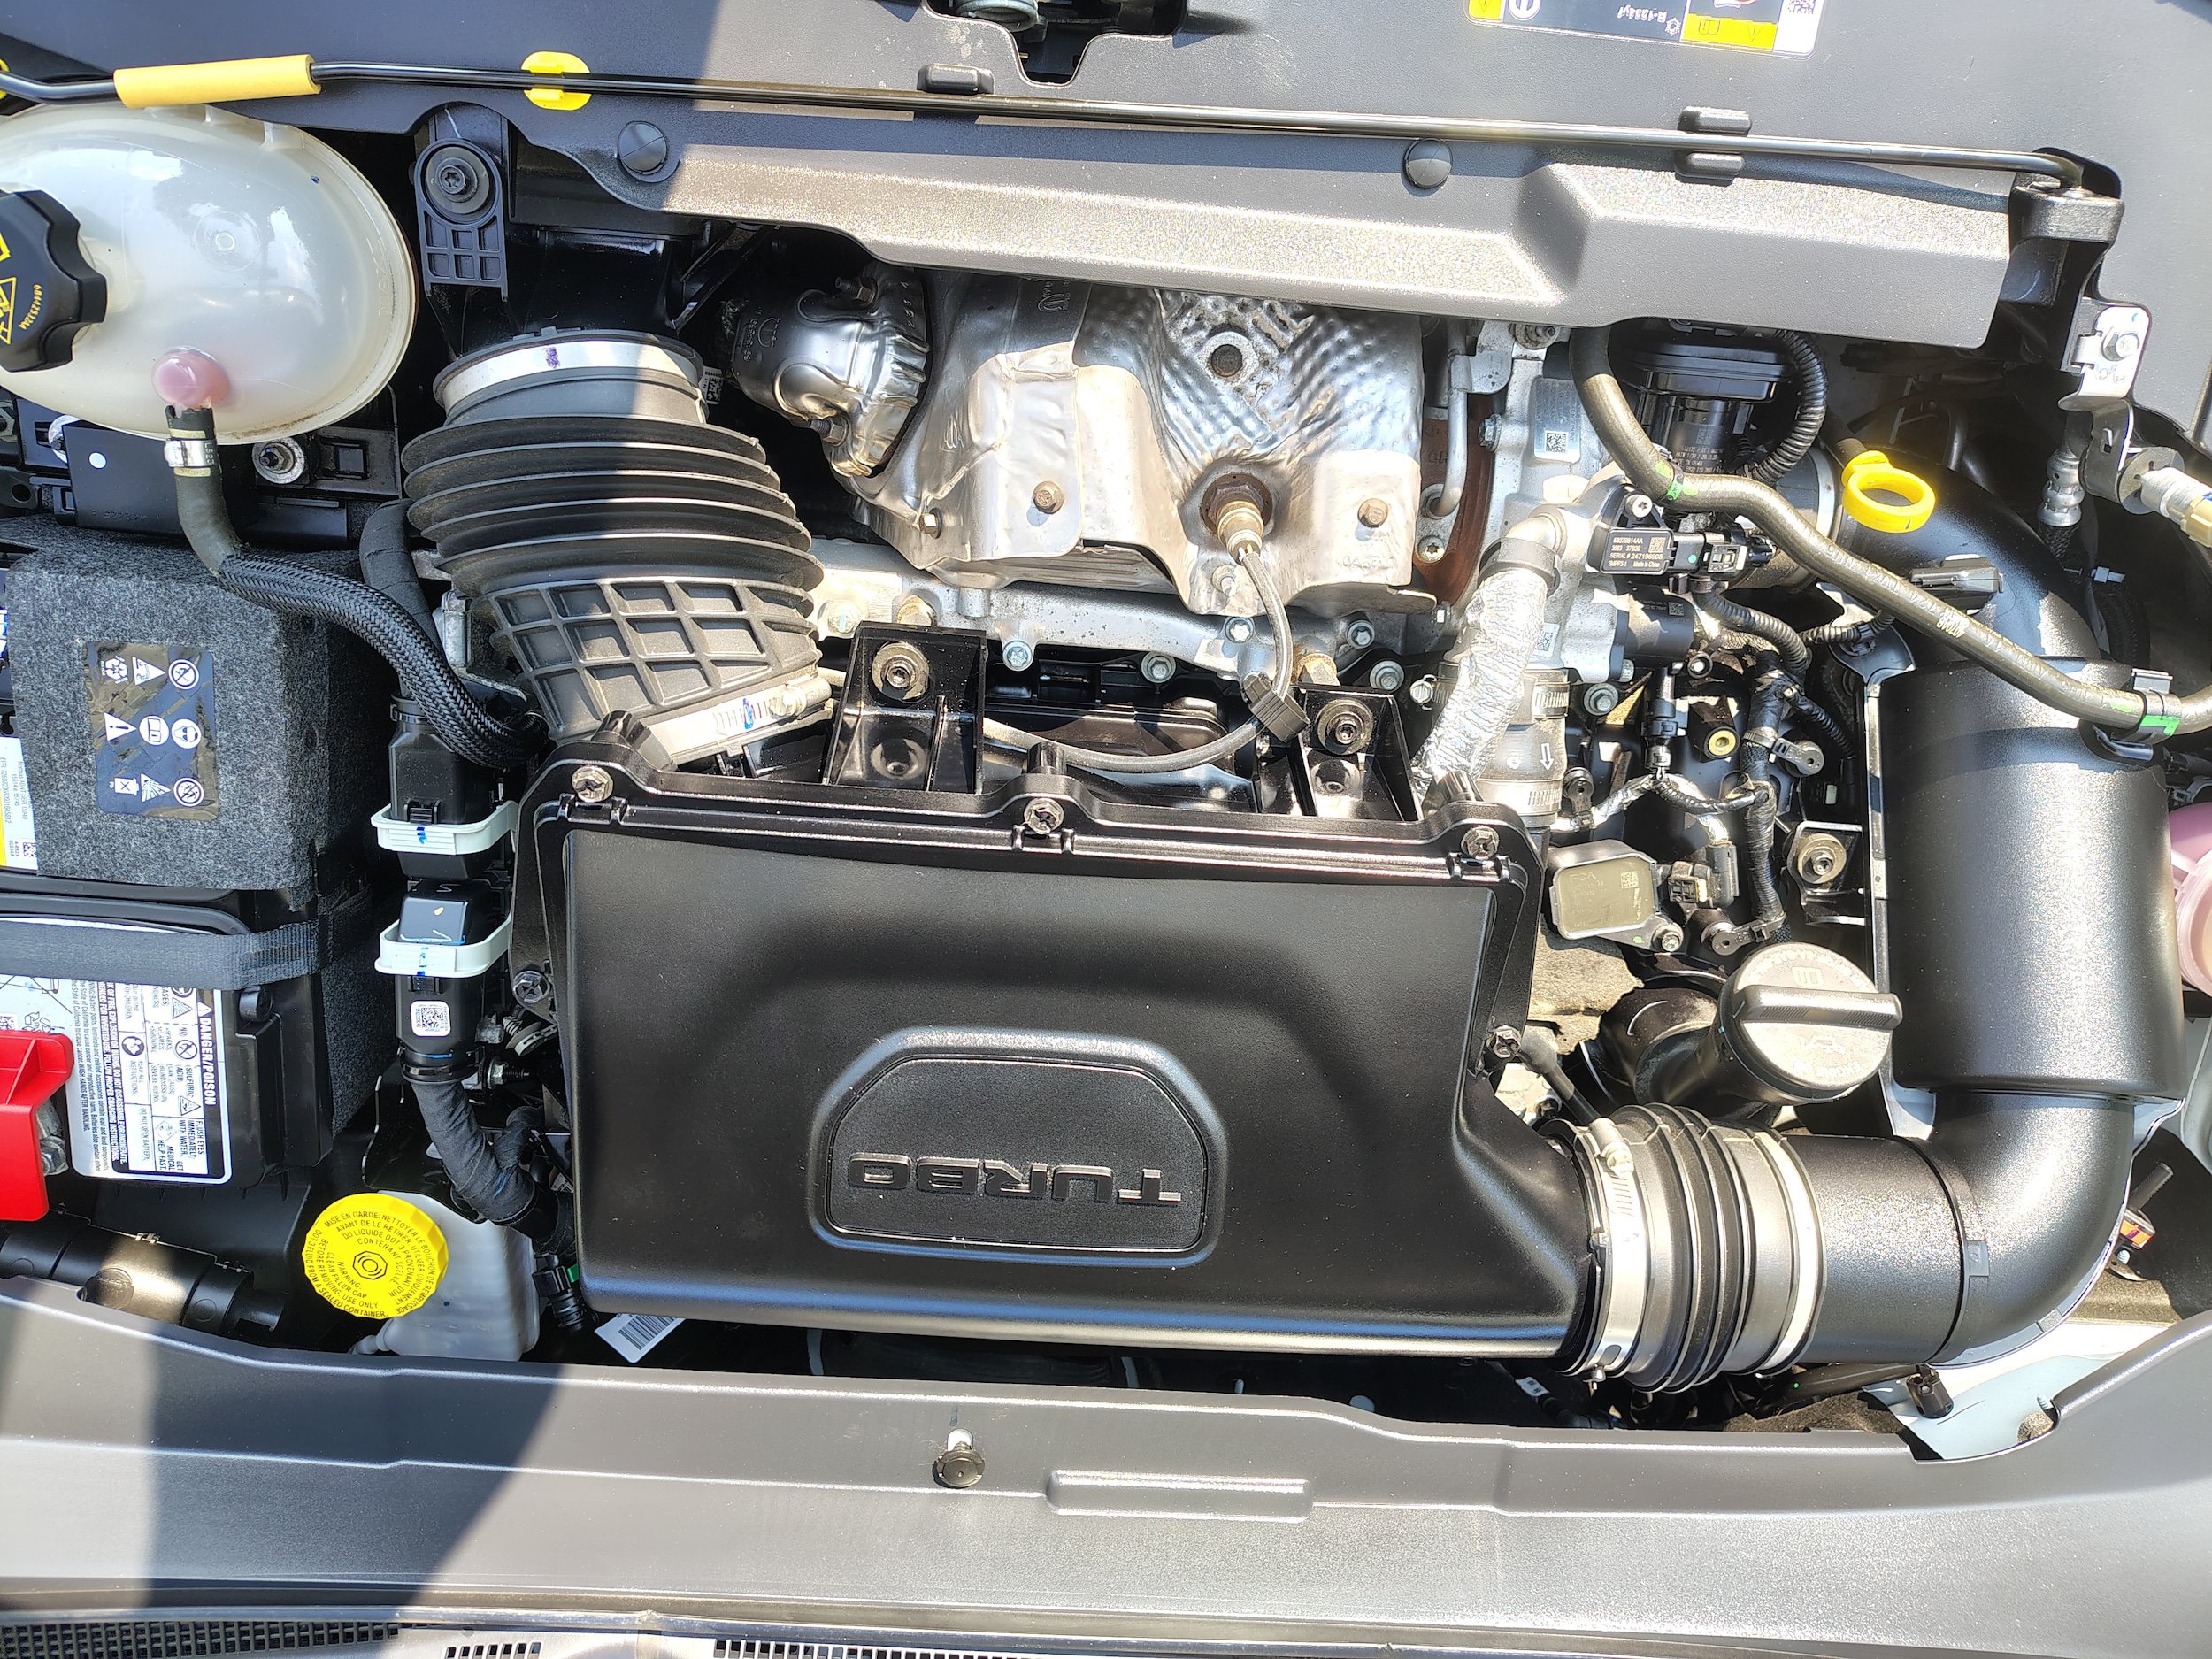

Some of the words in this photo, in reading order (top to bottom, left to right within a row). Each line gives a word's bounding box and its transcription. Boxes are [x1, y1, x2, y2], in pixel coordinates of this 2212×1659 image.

[104, 1054, 112, 1075] FOLLOW
[200, 1018, 216, 1105] DANGER/POISON
[105, 1076, 114, 1096] PROPER
[107, 1097, 116, 1123] CHARGING
[115, 1089, 125, 1125] DISASSEMBLE
[847, 1152, 1182, 1208] TURBO
[325, 1216, 340, 1227] MISE
[336, 1220, 358, 1233] AVANT
[382, 1215, 418, 1237] NETTOYER
[312, 1229, 323, 1241] DOT
[383, 1224, 412, 1244] RETIRER
[416, 1234, 425, 1244] LE
[355, 1229, 383, 1238] LIQUIDE
[386, 1234, 400, 1244] DOT
[403, 1250, 415, 1287] PROVENANT
[357, 1238, 401, 1259] CONTENANT
[421, 1245, 435, 1275] BOUCHON
[308, 1265, 319, 1283] FROM
[317, 1239, 328, 1263] BEFORE
[342, 1294, 357, 1304] USE
[337, 1261, 364, 1290] WARNING:
[427, 1276, 434, 1285] DE
[331, 1274, 351, 1292] FILLER
[395, 1274, 423, 1305] UNIQUEMENT
[319, 1288, 343, 1307] SEALED
[395, 1284, 432, 1314] REMPLISSAGE
[344, 1305, 388, 1317] CONTAINER.
